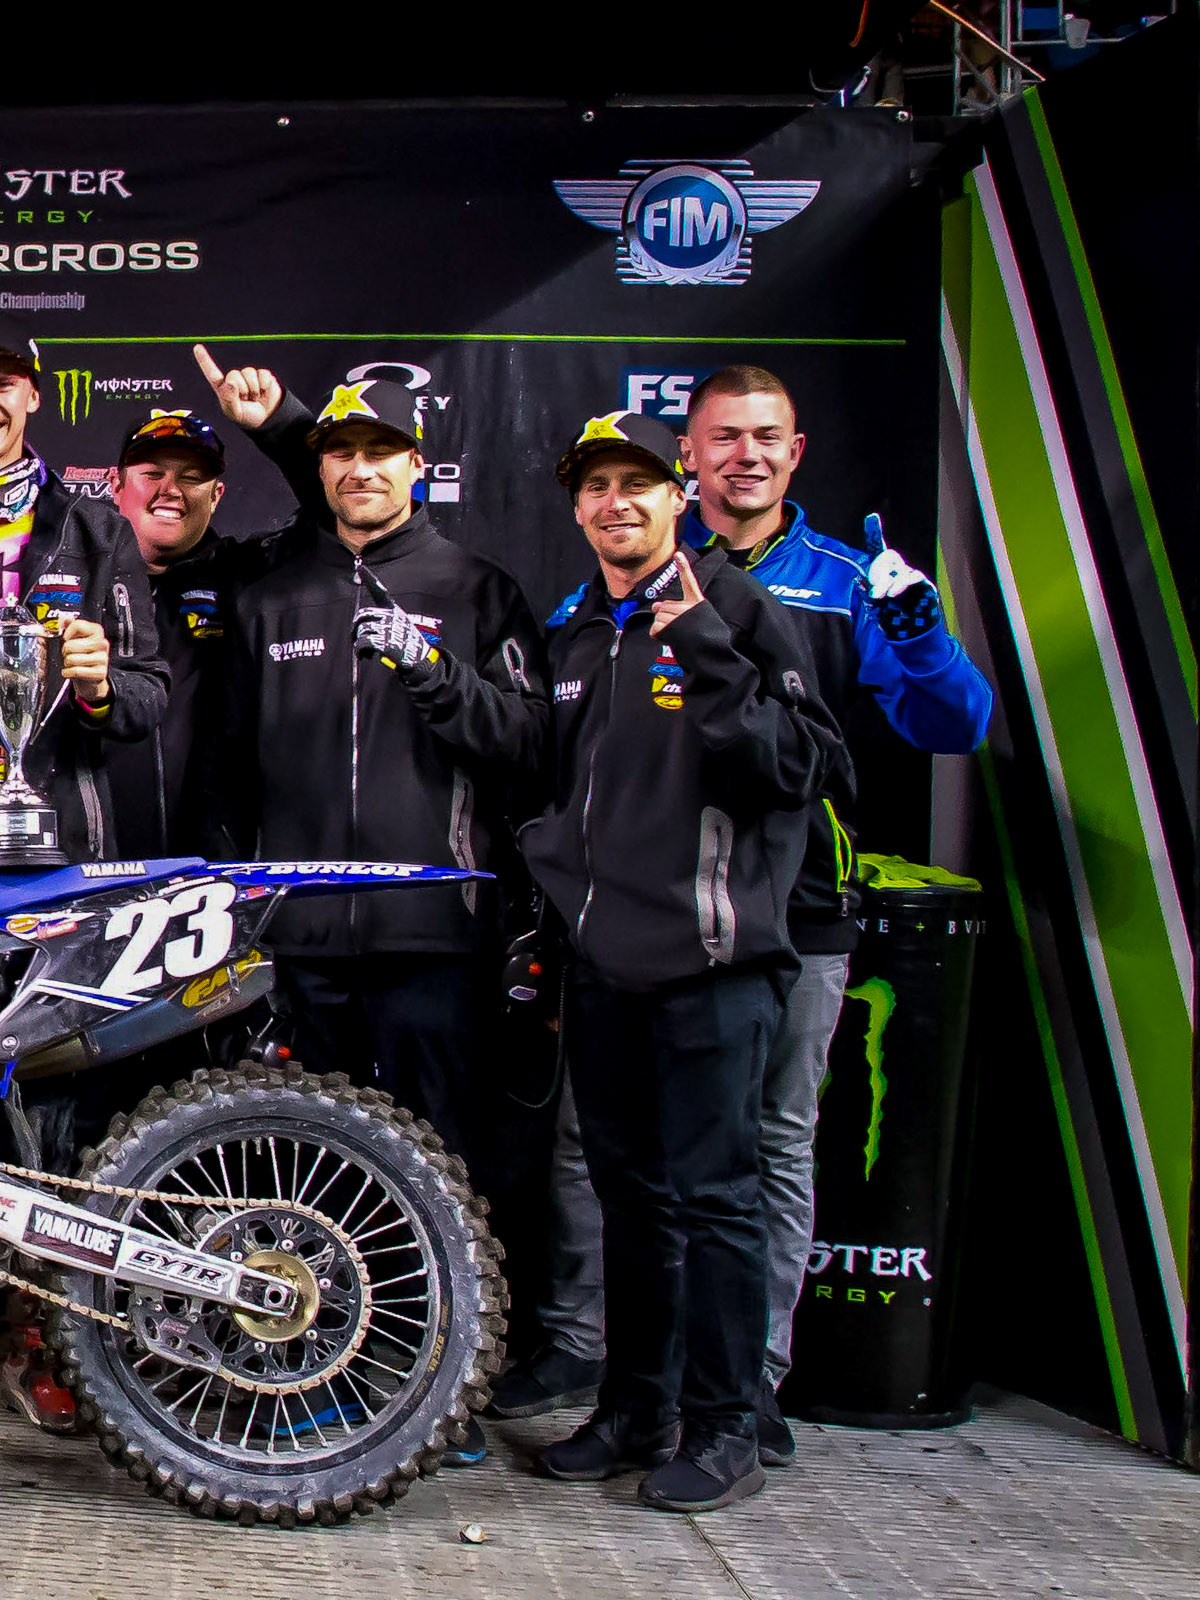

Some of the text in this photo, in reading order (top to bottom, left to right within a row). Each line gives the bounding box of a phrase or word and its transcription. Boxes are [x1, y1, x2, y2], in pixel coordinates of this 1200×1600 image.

[643, 196, 730, 248] FIM
[0, 291, 85, 311] Championship
[94, 378, 173, 392] MONSTER
[282, 638, 325, 655] YAMAHA
[81, 863, 146, 877] YAMAHA
[266, 864, 423, 877] DUNLOP
[103, 881, 236, 995] 23
[34, 1209, 116, 1257] YAMALUBE
[132, 1250, 225, 1284] GYTR
